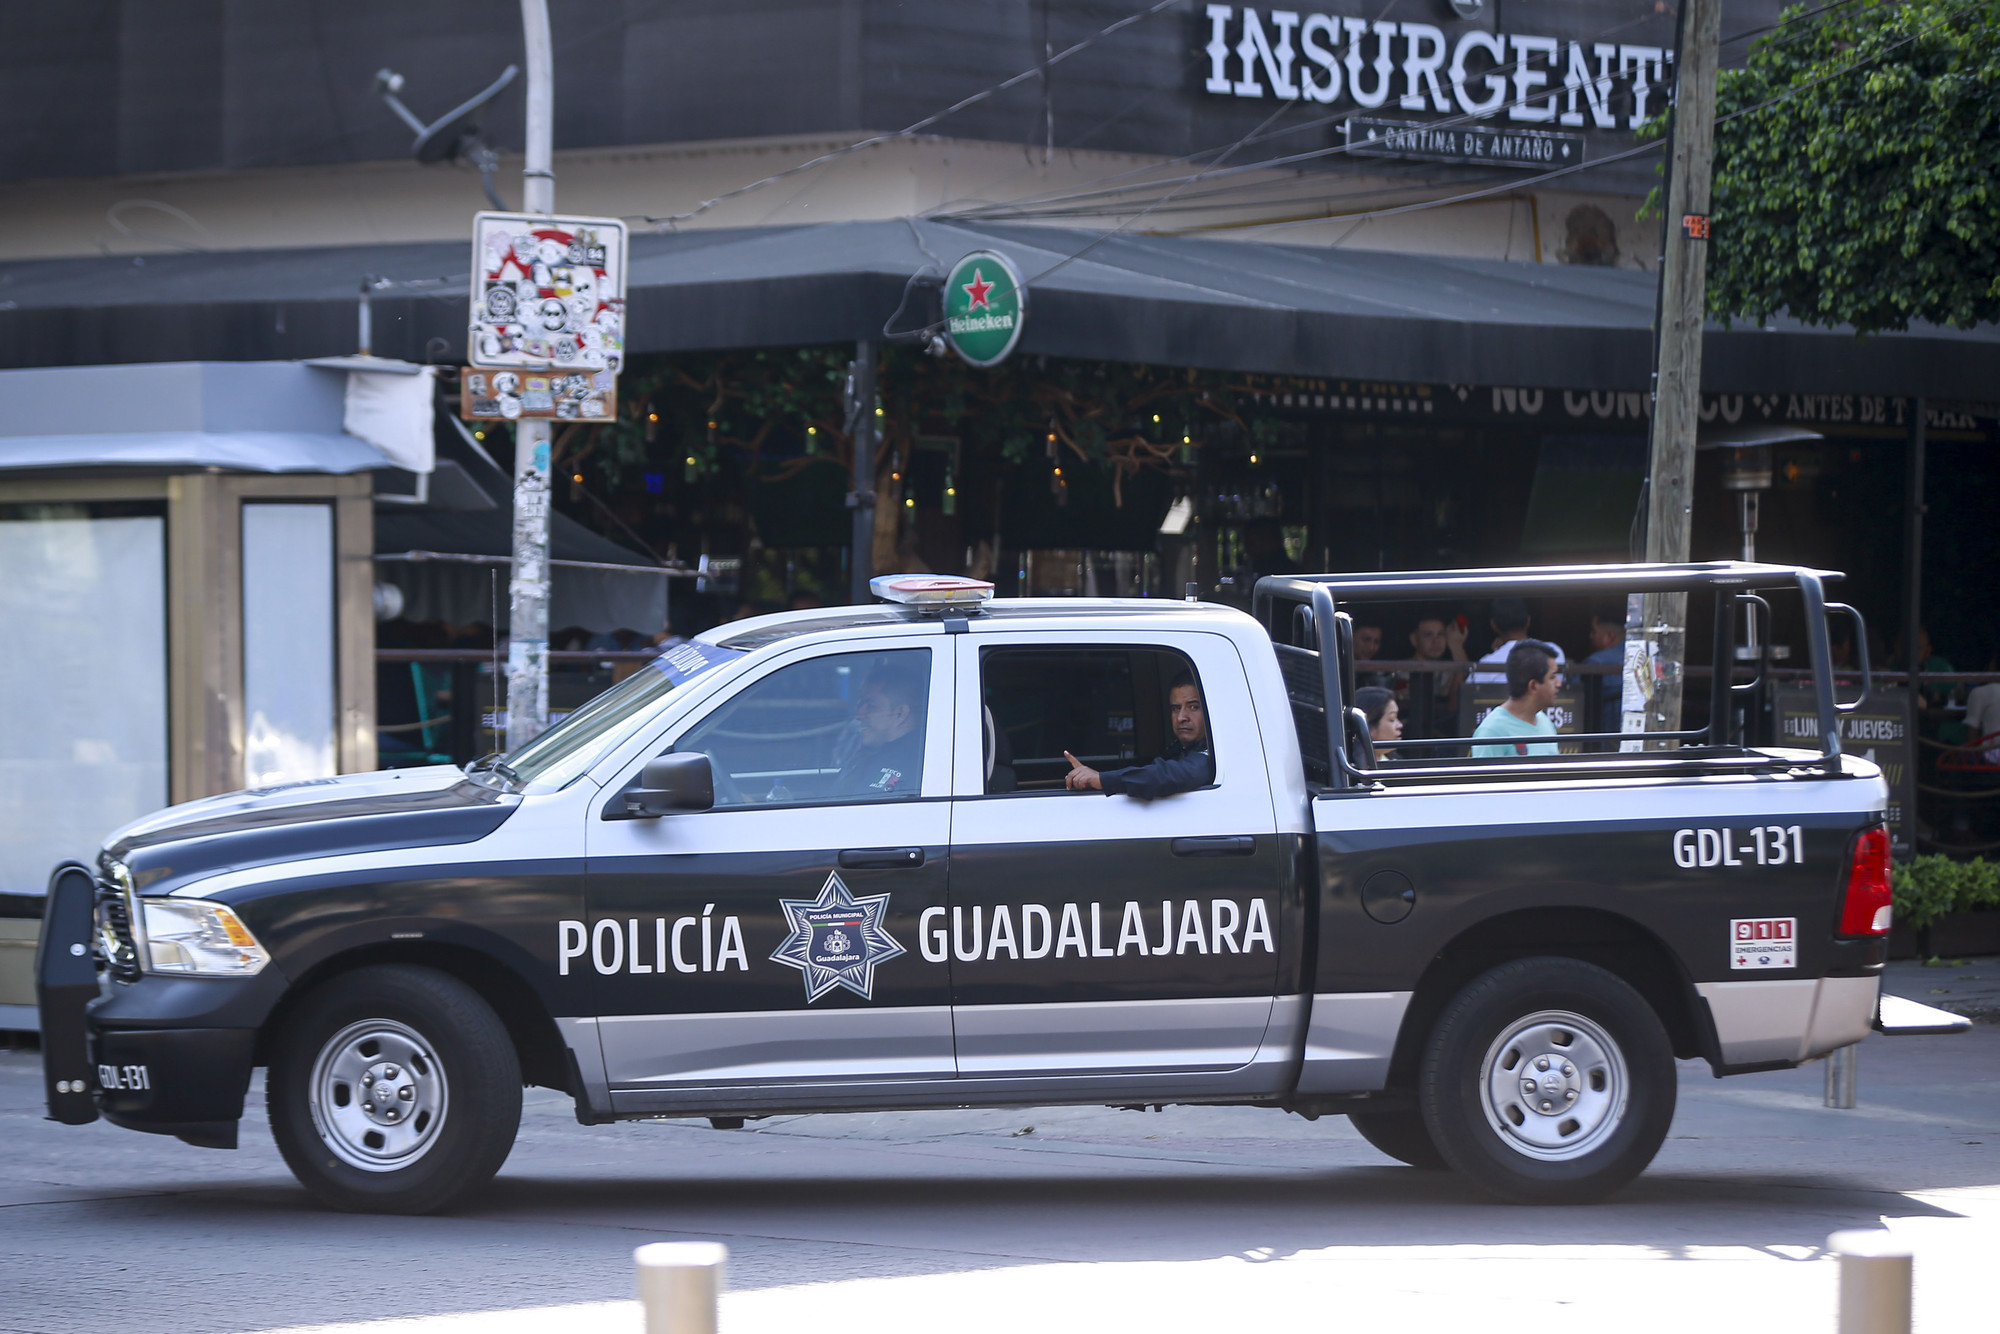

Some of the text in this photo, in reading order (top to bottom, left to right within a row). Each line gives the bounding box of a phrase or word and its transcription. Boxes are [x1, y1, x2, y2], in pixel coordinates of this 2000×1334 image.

[1206, 5, 1677, 129] INSURGENT
[1384, 125, 1555, 161] CANTINA DE ANTAÑO
[950, 313, 1014, 335] Heineken
[1785, 393, 1854, 422] ANTES
[1859, 395, 1886, 424] DE
[1794, 717, 1819, 738] LUN
[1848, 718, 1894, 740] JUEVES
[1673, 825, 1803, 868] GDL-131
[559, 903, 749, 976] POLICÍA
[918, 899, 1274, 963] GUADALAJARA
[1737, 922, 1788, 939] 911
[816, 954, 859, 962] Guadalajara
[1735, 945, 1792, 953] EMERGENCIAS
